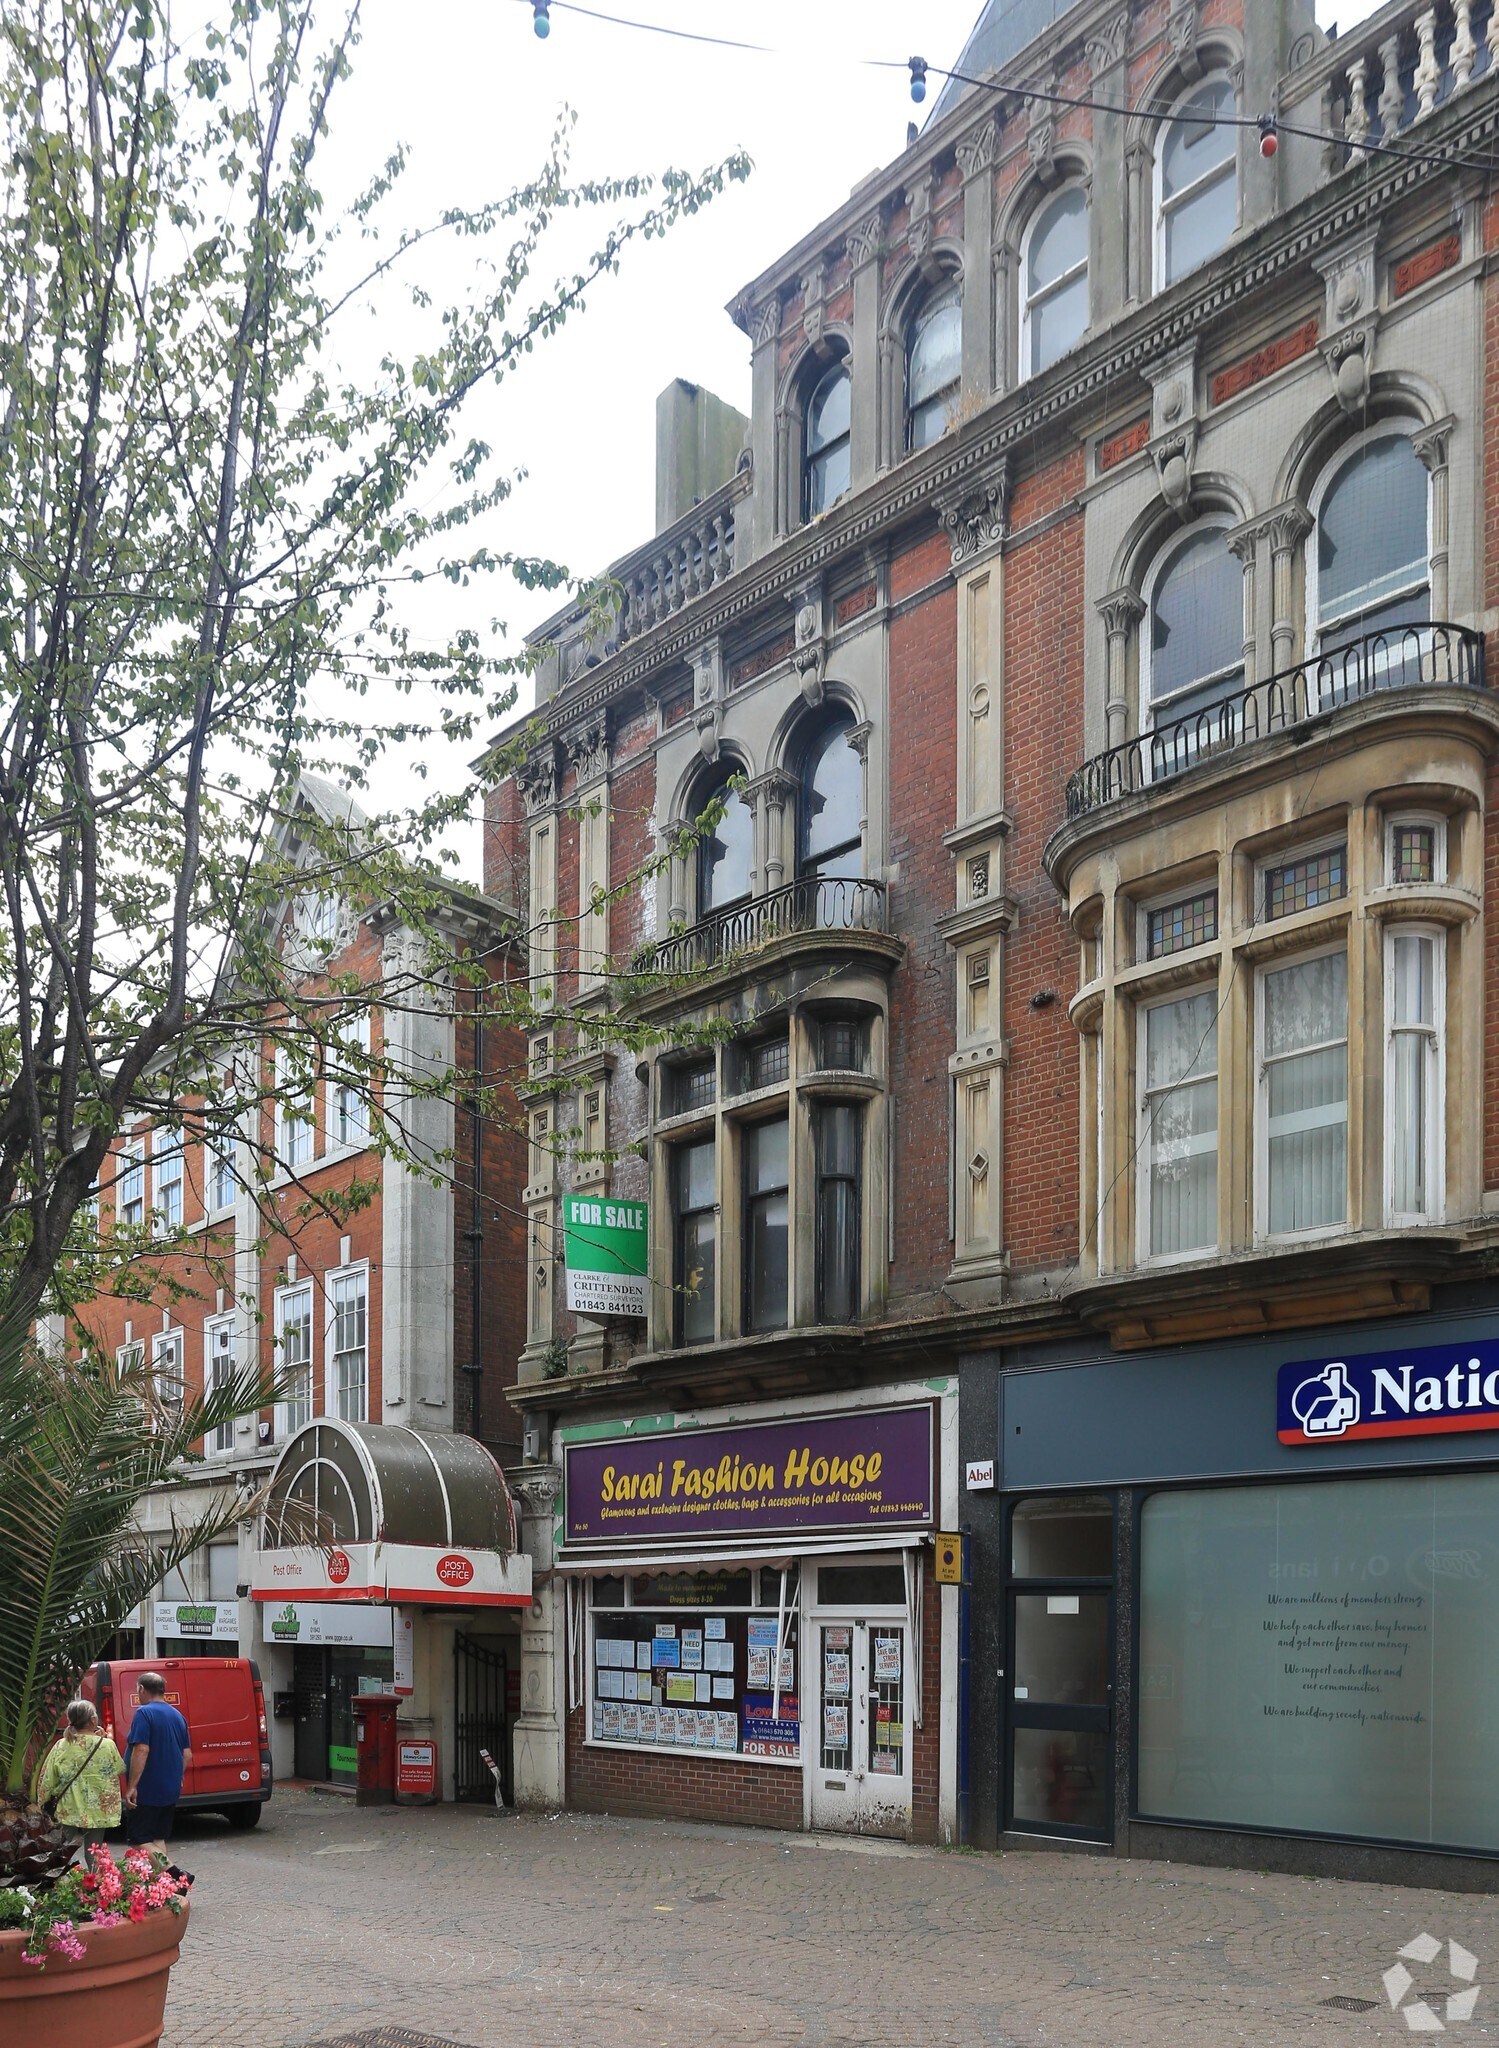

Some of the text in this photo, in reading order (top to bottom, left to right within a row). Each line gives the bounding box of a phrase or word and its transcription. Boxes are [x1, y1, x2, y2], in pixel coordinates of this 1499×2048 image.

[571, 1202, 643, 1230] FOR SALE
[574, 1274, 610, 1282] CLARKE &
[574, 1282, 644, 1296] CRITTENDEN
[574, 1291, 644, 1304] CHARTERED SURVEYORS
[575, 1300, 644, 1314] 01843 841123
[601, 1448, 882, 1502] Sarai Fashion House
[968, 1468, 992, 1482] Abel
[601, 1489, 882, 1520] Glamorous and exclusive designer clothes, bags & accessories for all occasions
[869, 1505, 879, 1514] Tel
[880, 1504, 899, 1513] 01843
[273, 1564, 302, 1576] Post Office
[444, 1561, 466, 1570] POST
[330, 1567, 348, 1576] OFFICE
[440, 1570, 470, 1580] OFFICE
[1268, 1594, 1283, 1604] We
[1300, 1592, 1338, 1604] millions
[1340, 1592, 1350, 1608] of
[1350, 1592, 1392, 1604] members
[1263, 1620, 1278, 1631] We
[1280, 1619, 1300, 1635] help
[1302, 1620, 1326, 1632] each
[1326, 1620, 1350, 1632] other
[1374, 1620, 1392, 1638] buy
[1394, 1620, 1427, 1632] homes
[684, 1640, 700, 1648] NEED
[1278, 1636, 1295, 1648] and
[1296, 1636, 1311, 1651] get
[1312, 1640, 1334, 1648] more
[1334, 1636, 1358, 1651] from
[1360, 1640, 1375, 1648] our
[877, 1648, 888, 1656] SAVE
[750, 1656, 758, 1664] SAVE
[882, 1654, 899, 1662] STROKE
[224, 1660, 238, 1668] 717
[878, 1661, 899, 1670] SERVICES
[832, 1670, 848, 1678] STROKE
[1284, 1664, 1402, 1678] We support each other and
[828, 1676, 848, 1684] SERVICES
[746, 1704, 798, 1720] Lovtts
[1264, 1705, 1278, 1716] We
[1280, 1708, 1294, 1716] are
[1294, 1705, 1334, 1721] building
[826, 1716, 836, 1724] SAVE
[831, 1722, 846, 1730] STROKE
[774, 1728, 784, 1736] 570
[208, 1740, 252, 1748] www.royalmail.com
[742, 1741, 800, 1758] FOR SALE
[336, 1754, 358, 1763] Tournam
